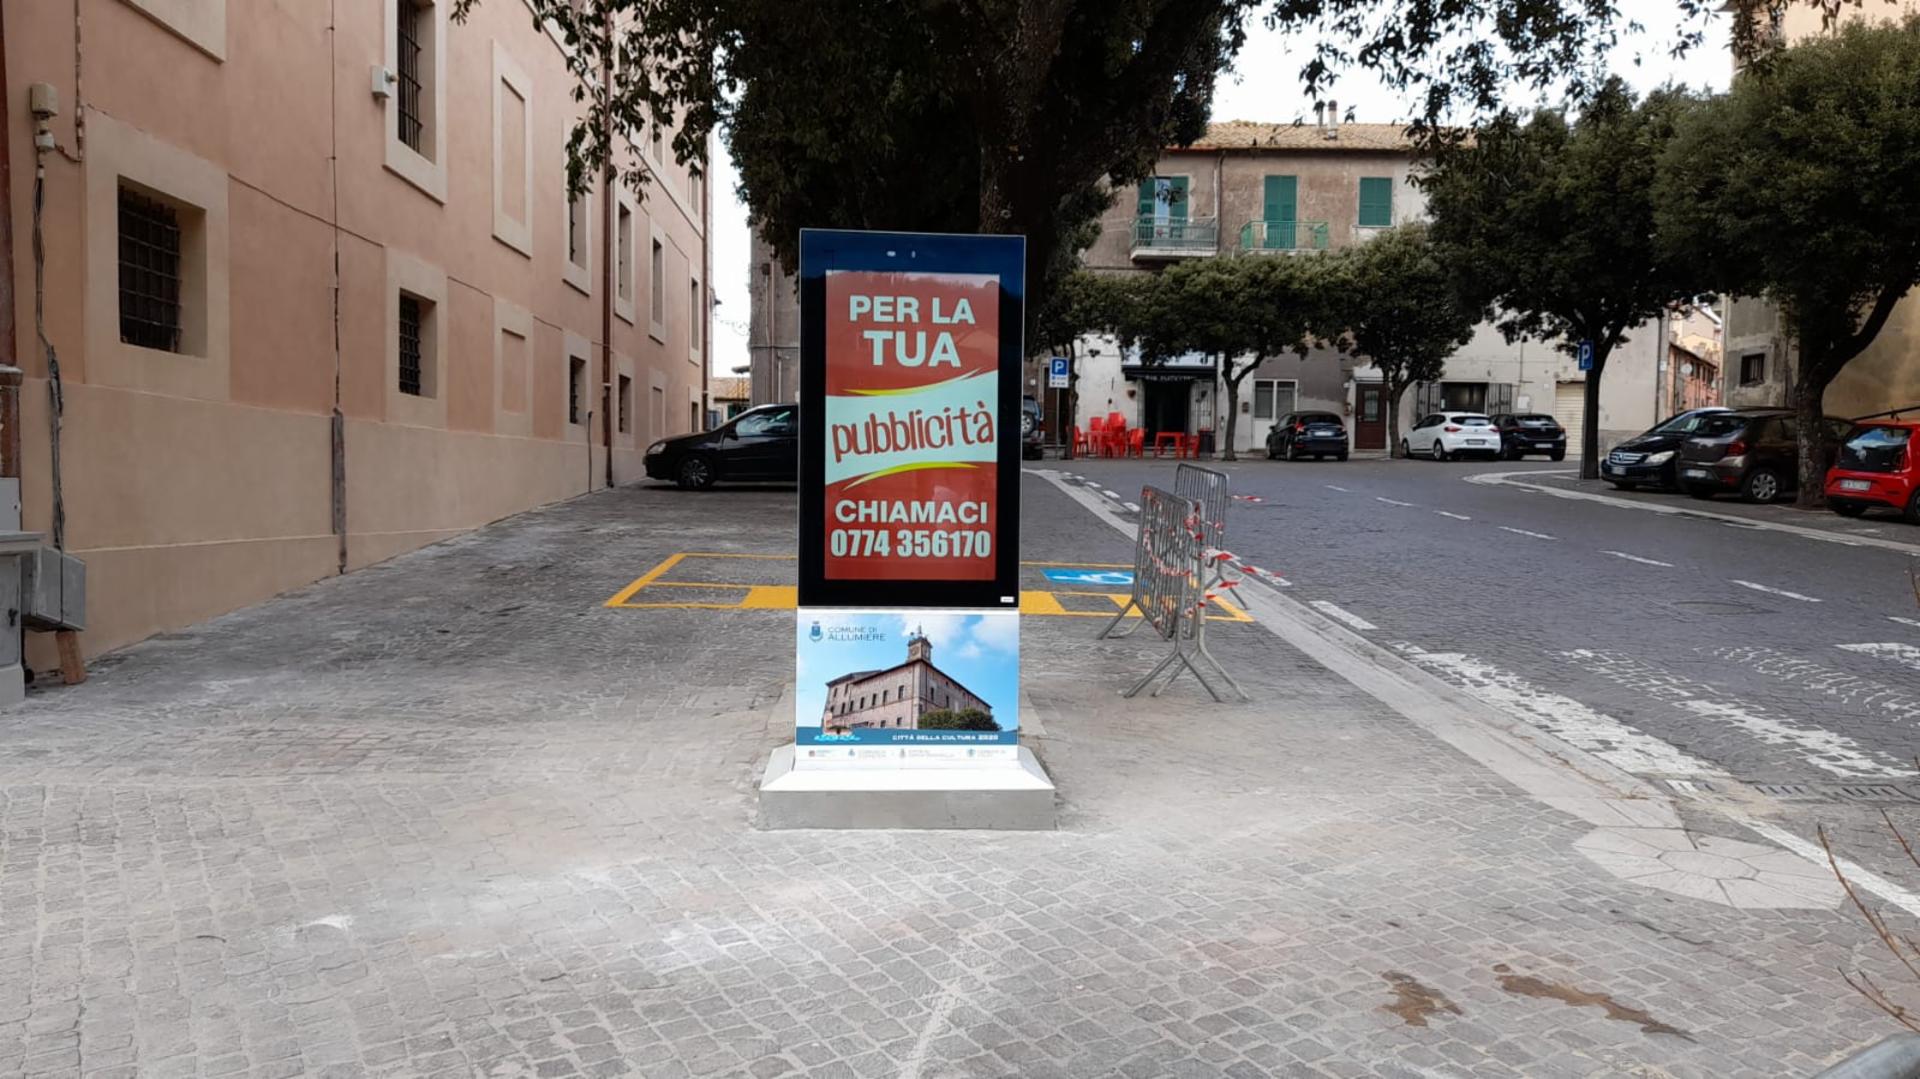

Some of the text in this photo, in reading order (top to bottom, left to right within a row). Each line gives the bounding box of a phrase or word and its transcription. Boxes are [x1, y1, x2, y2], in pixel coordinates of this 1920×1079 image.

[850, 295, 975, 325] PER LA
[863, 330, 962, 368] TUA
[831, 401, 995, 463] pubblicità
[835, 499, 988, 524] CHIAMACI
[831, 529, 991, 559] 0774 356170
[827, 633, 887, 641] ALLUMIERE
